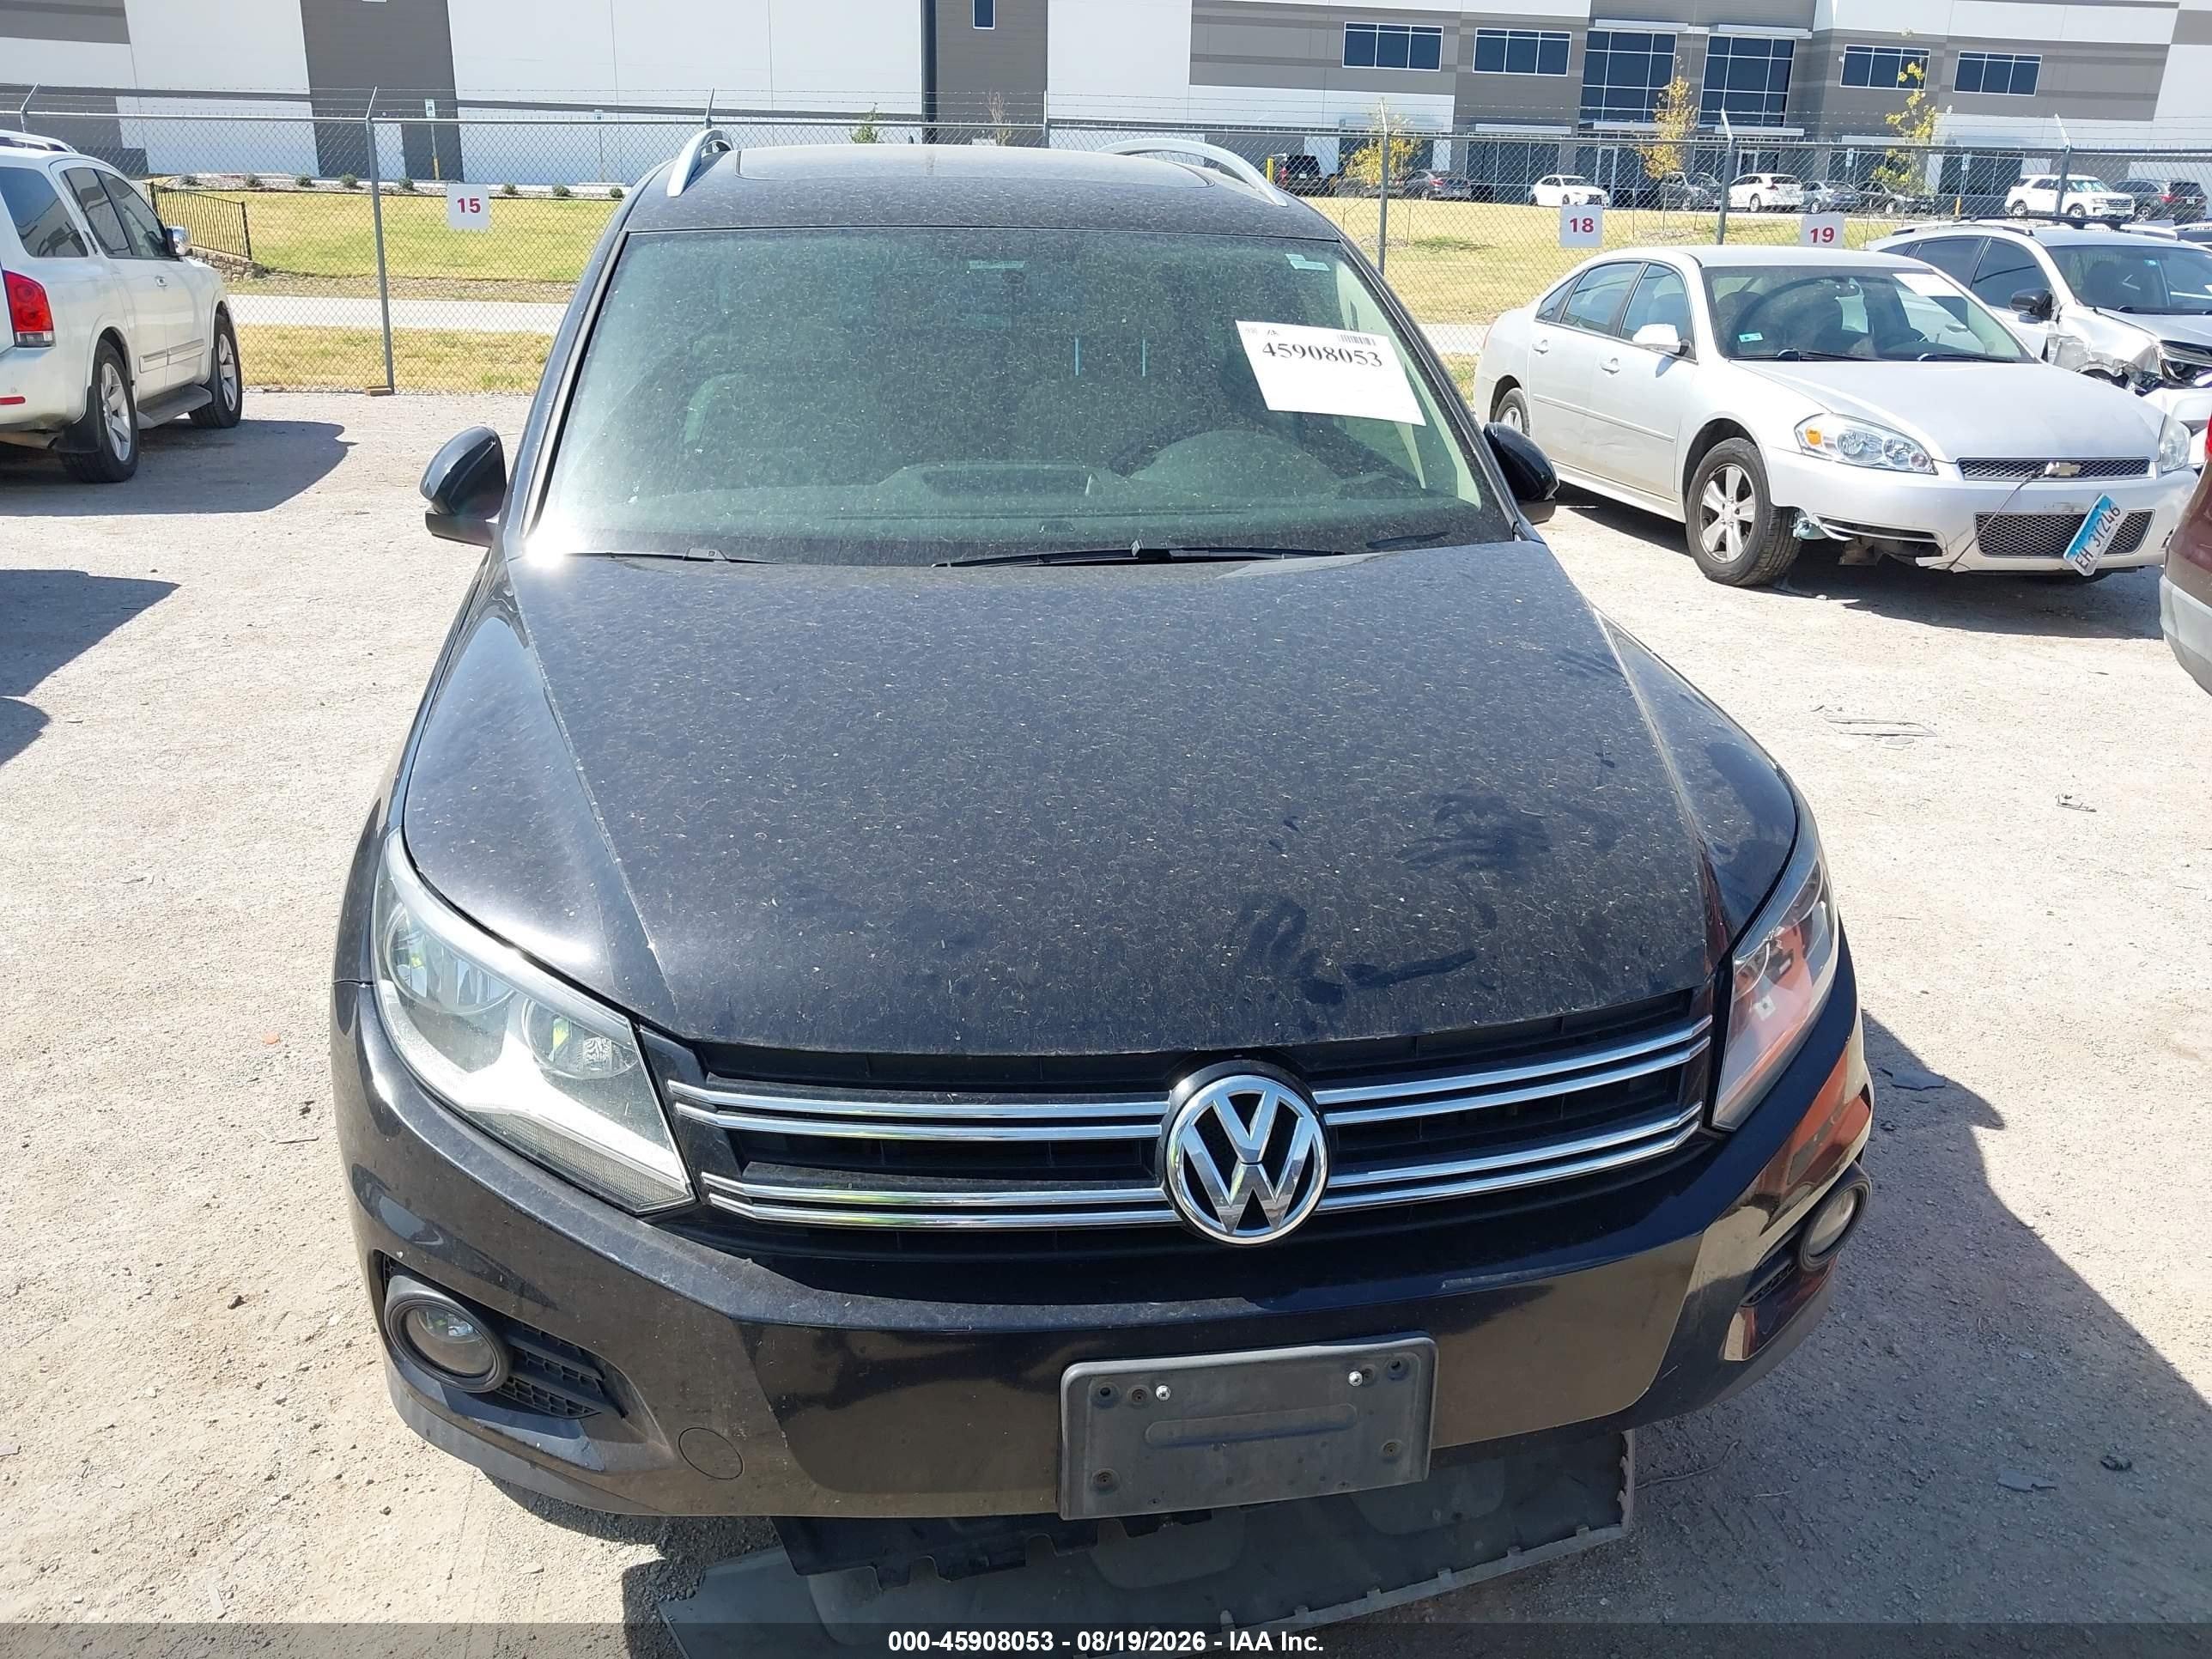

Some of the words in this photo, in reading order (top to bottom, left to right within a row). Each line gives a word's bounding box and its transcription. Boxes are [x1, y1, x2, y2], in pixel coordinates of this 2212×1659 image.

[457, 198, 481, 214] 15
[1569, 217, 1595, 234] 18
[1809, 227, 1835, 244] 19
[1262, 342, 1383, 368] 45908053
[2075, 546, 2094, 569] EH
[2087, 502, 2121, 548] 37246
